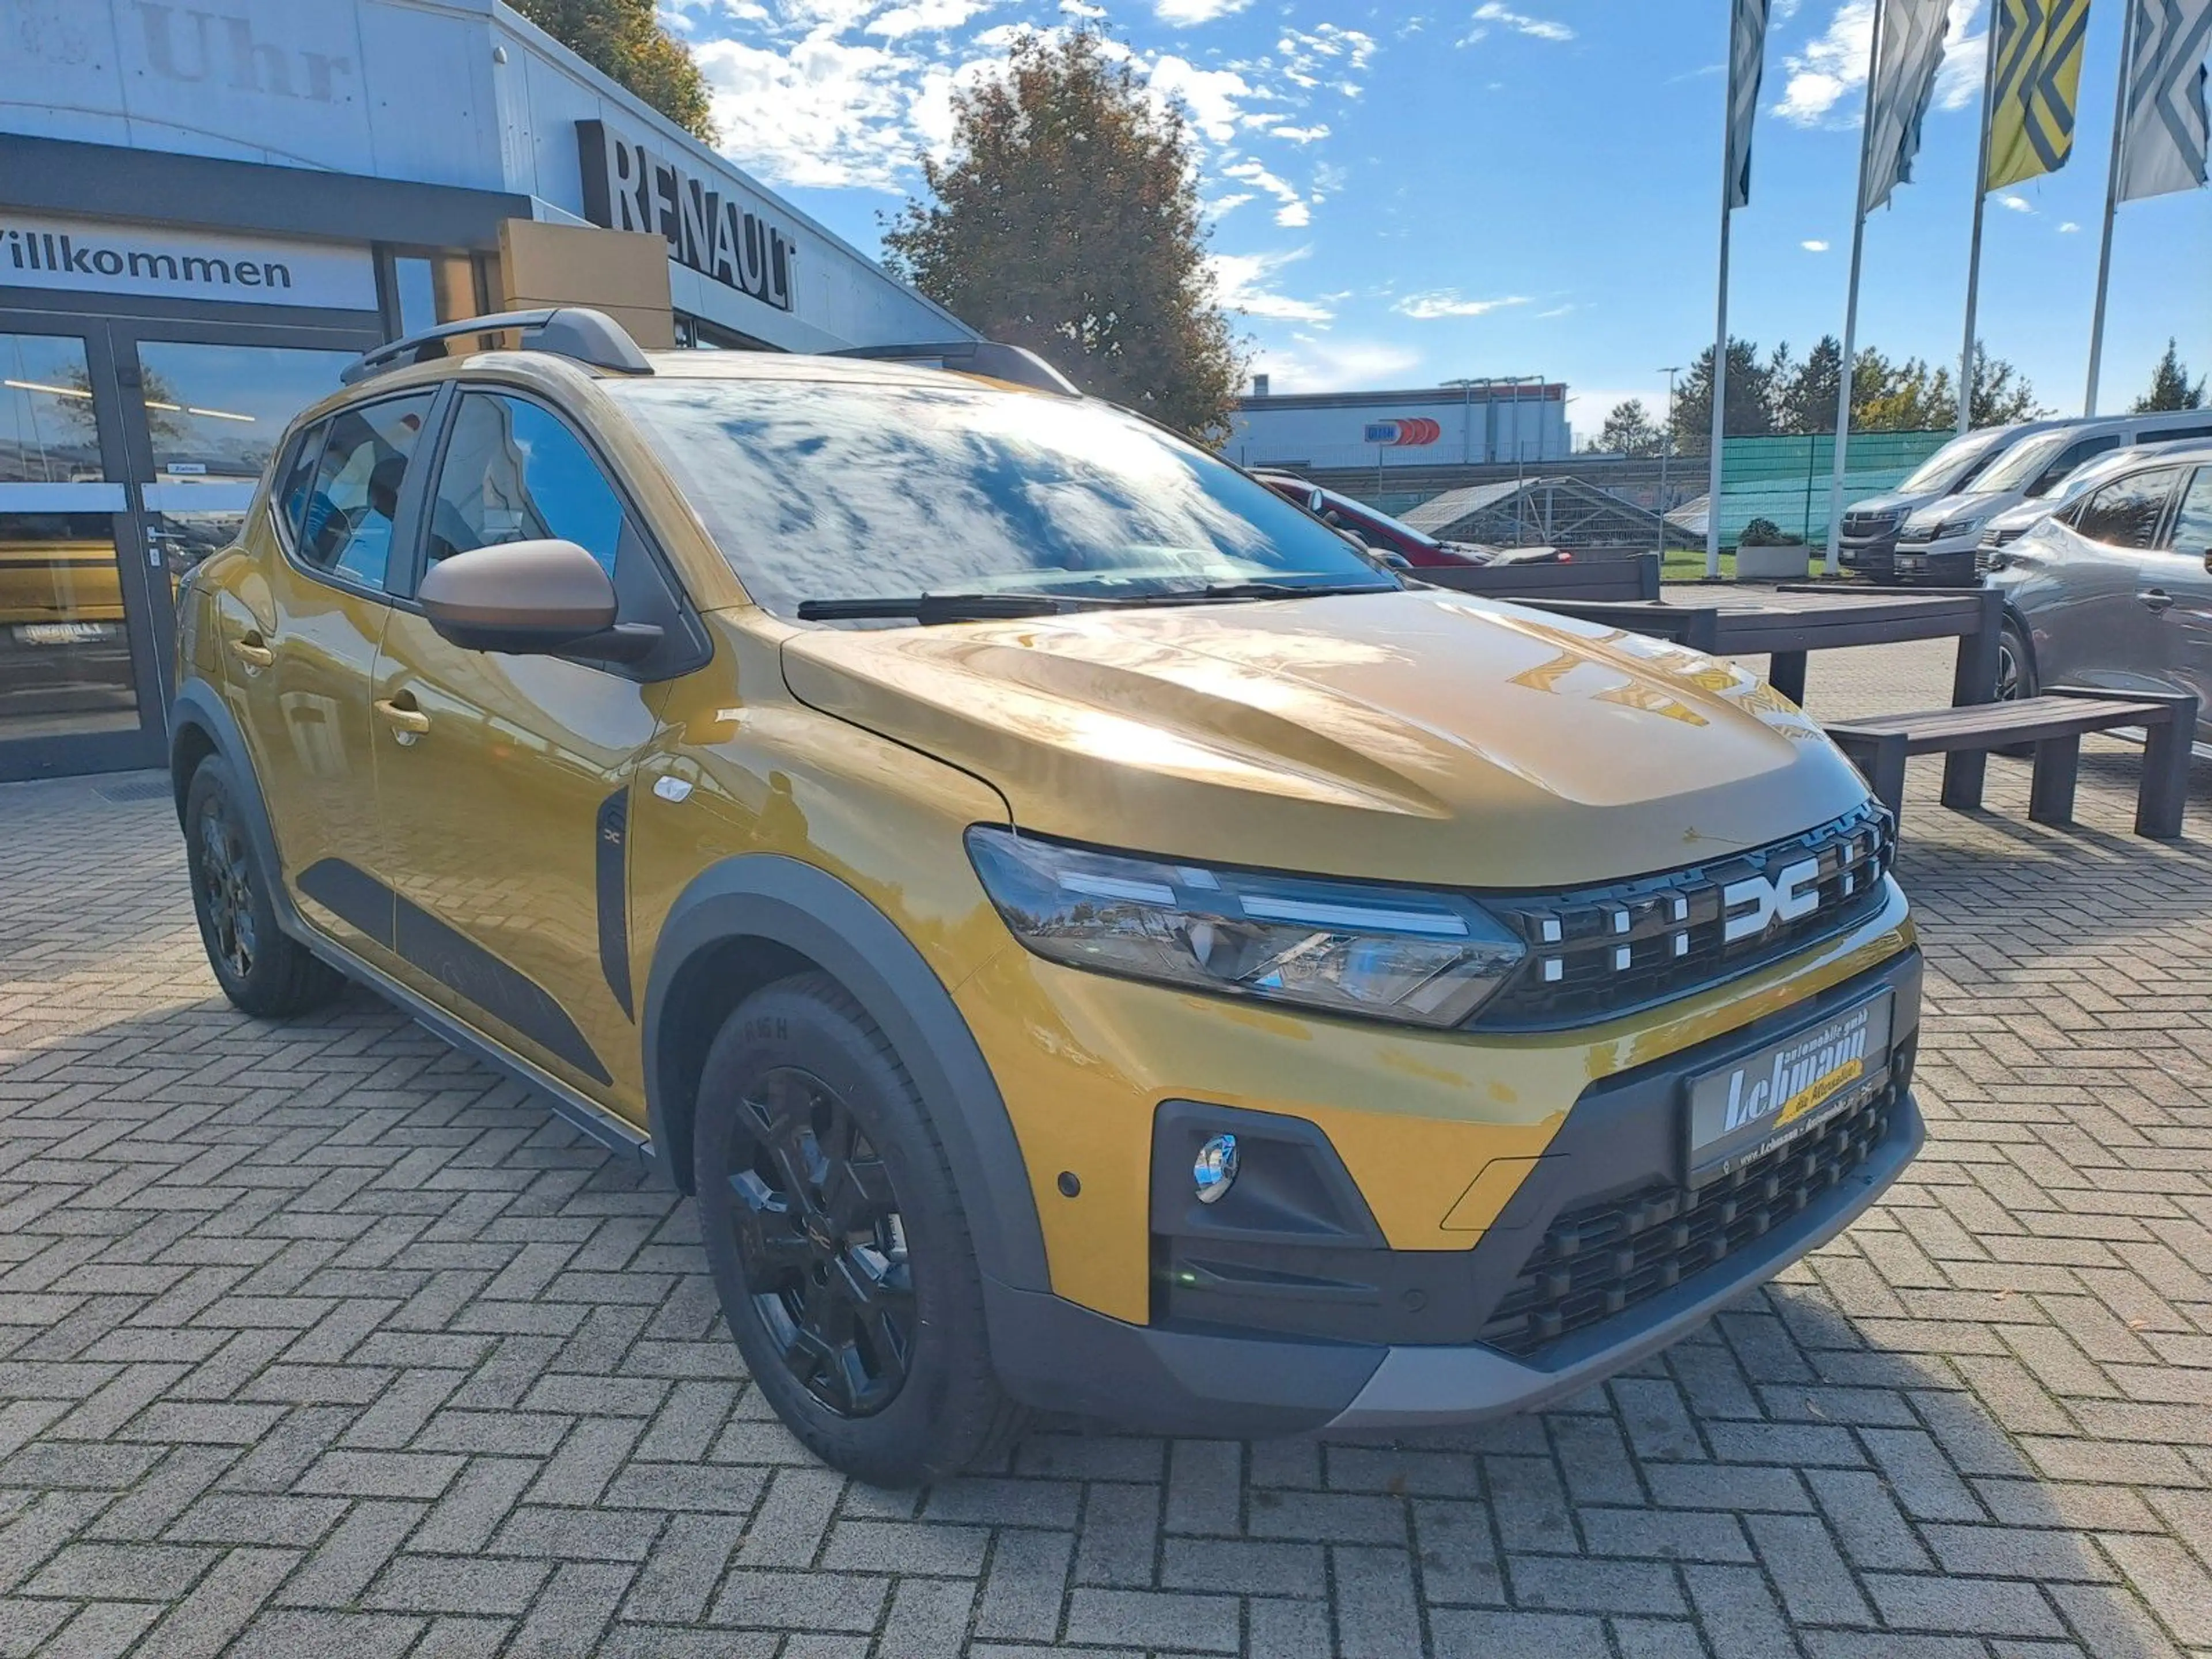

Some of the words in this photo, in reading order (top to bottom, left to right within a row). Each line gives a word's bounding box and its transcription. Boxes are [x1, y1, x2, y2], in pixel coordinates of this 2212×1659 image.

[129, 1, 351, 104] Uhr
[0, 230, 291, 288] illkommen
[575, 119, 796, 312] RENAULT
[1724, 1027, 1866, 1131] Lehmann
